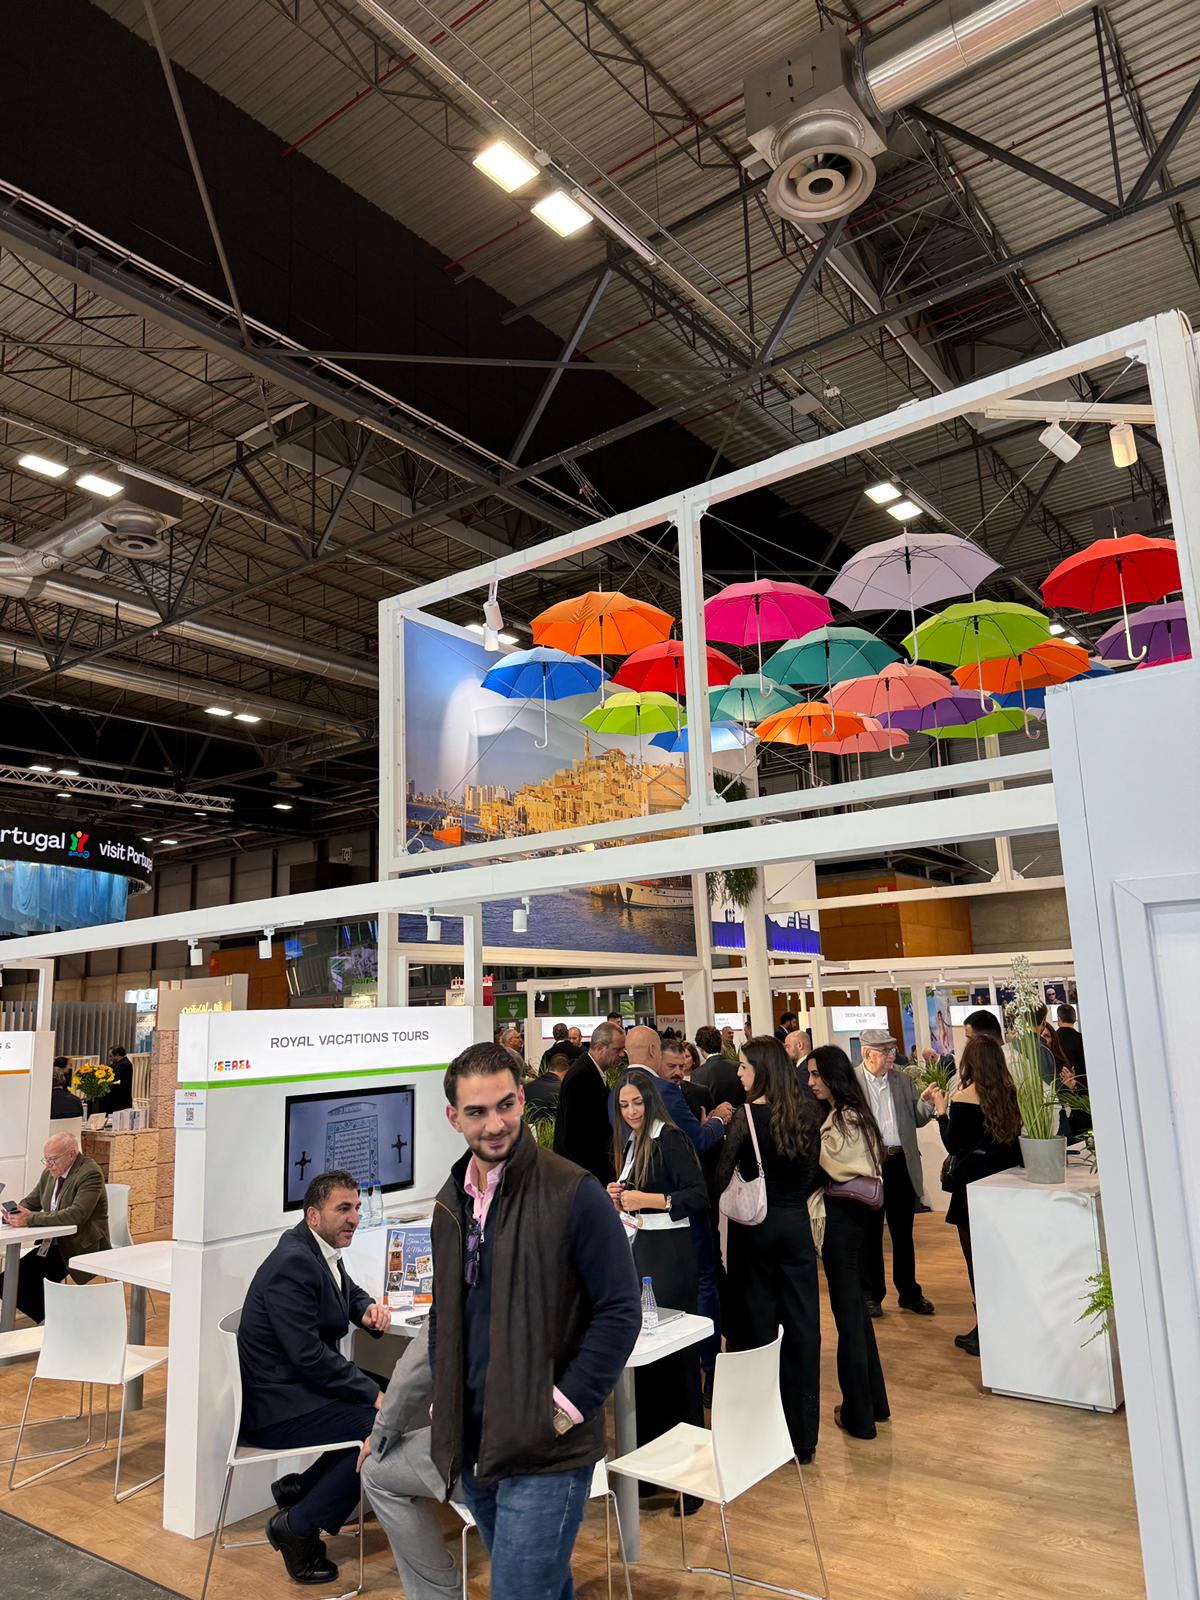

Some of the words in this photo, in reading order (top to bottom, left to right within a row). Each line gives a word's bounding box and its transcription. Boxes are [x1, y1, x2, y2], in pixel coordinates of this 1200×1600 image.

[0, 827, 66, 852] rtugal
[99, 840, 126, 861] visit
[126, 845, 153, 874] Portuga
[270, 1036, 315, 1049] ROYAL
[318, 1032, 389, 1046] VACATIONS
[391, 1030, 429, 1043] TOURS
[213, 1059, 251, 1072] ISRAEL
